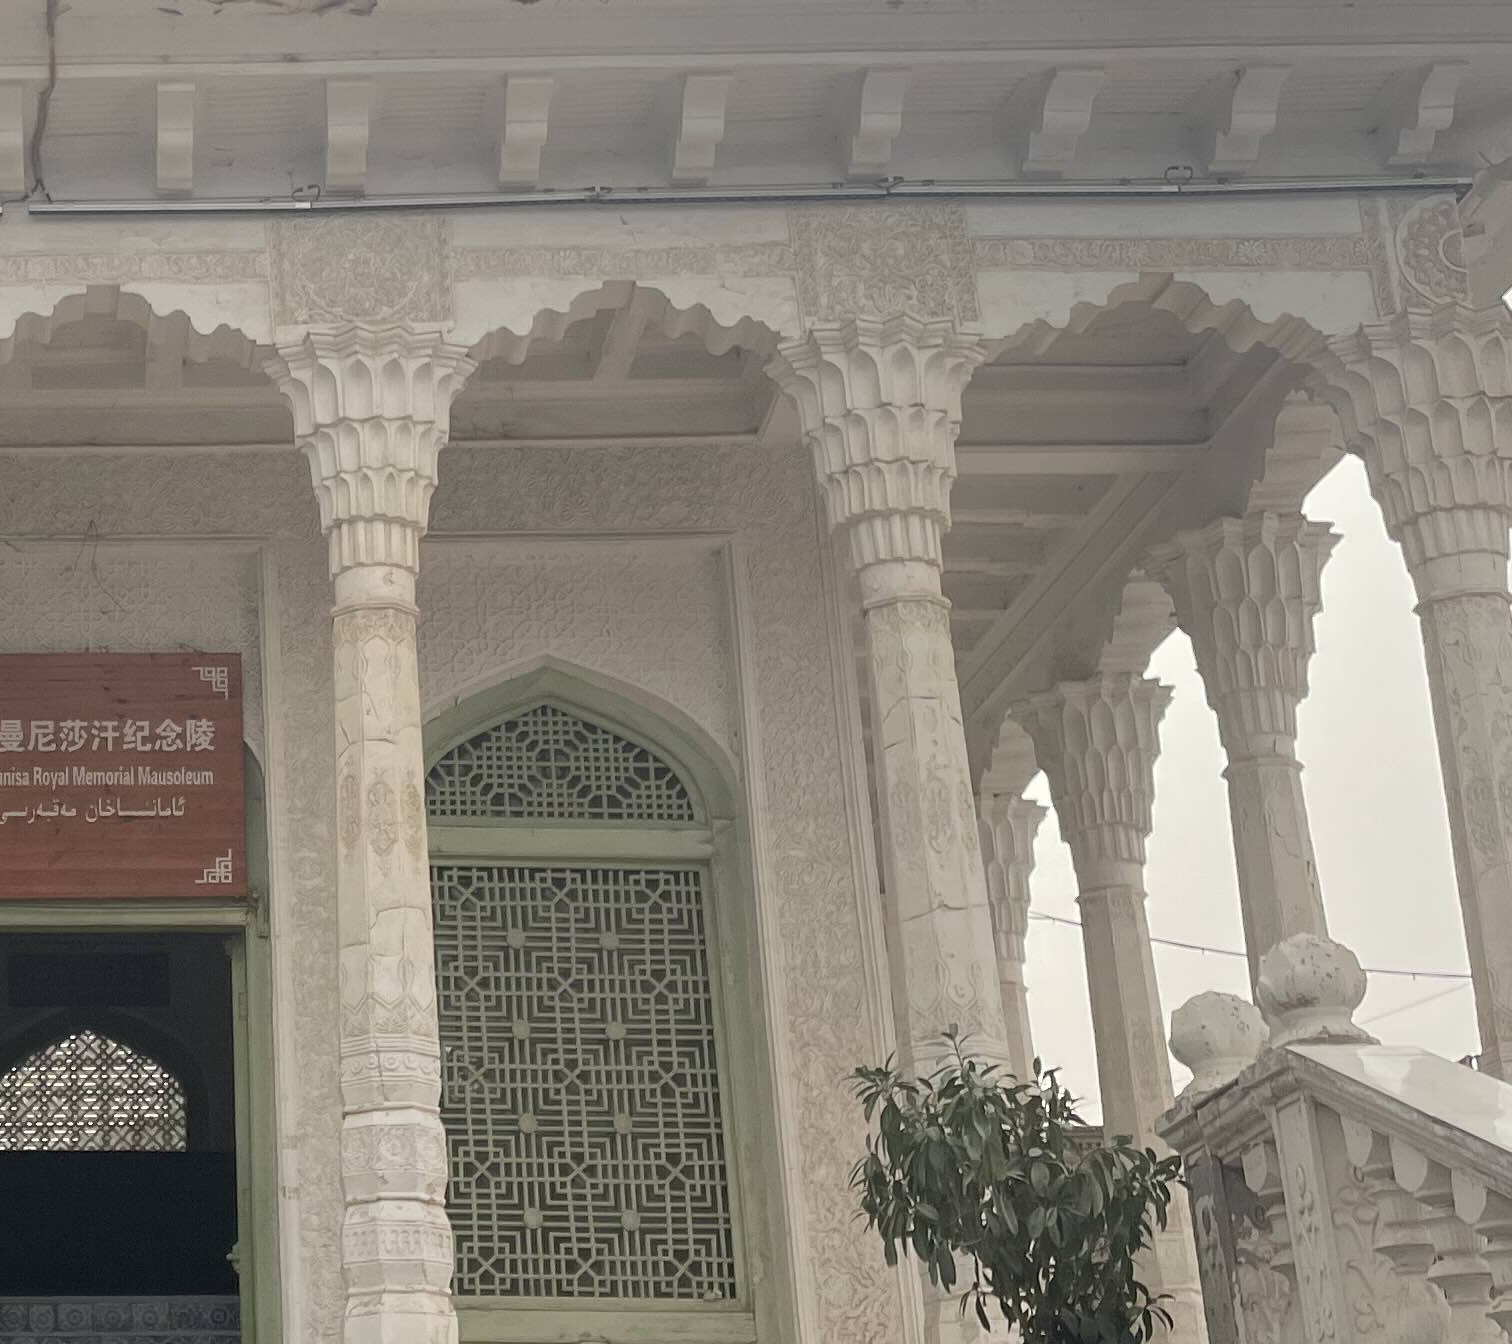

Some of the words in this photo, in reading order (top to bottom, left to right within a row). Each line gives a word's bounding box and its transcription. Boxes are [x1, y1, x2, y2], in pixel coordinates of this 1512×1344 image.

[33, 766, 69, 791] Royal
[73, 766, 134, 786] Memorial
[139, 766, 215, 786] Mausoleum
